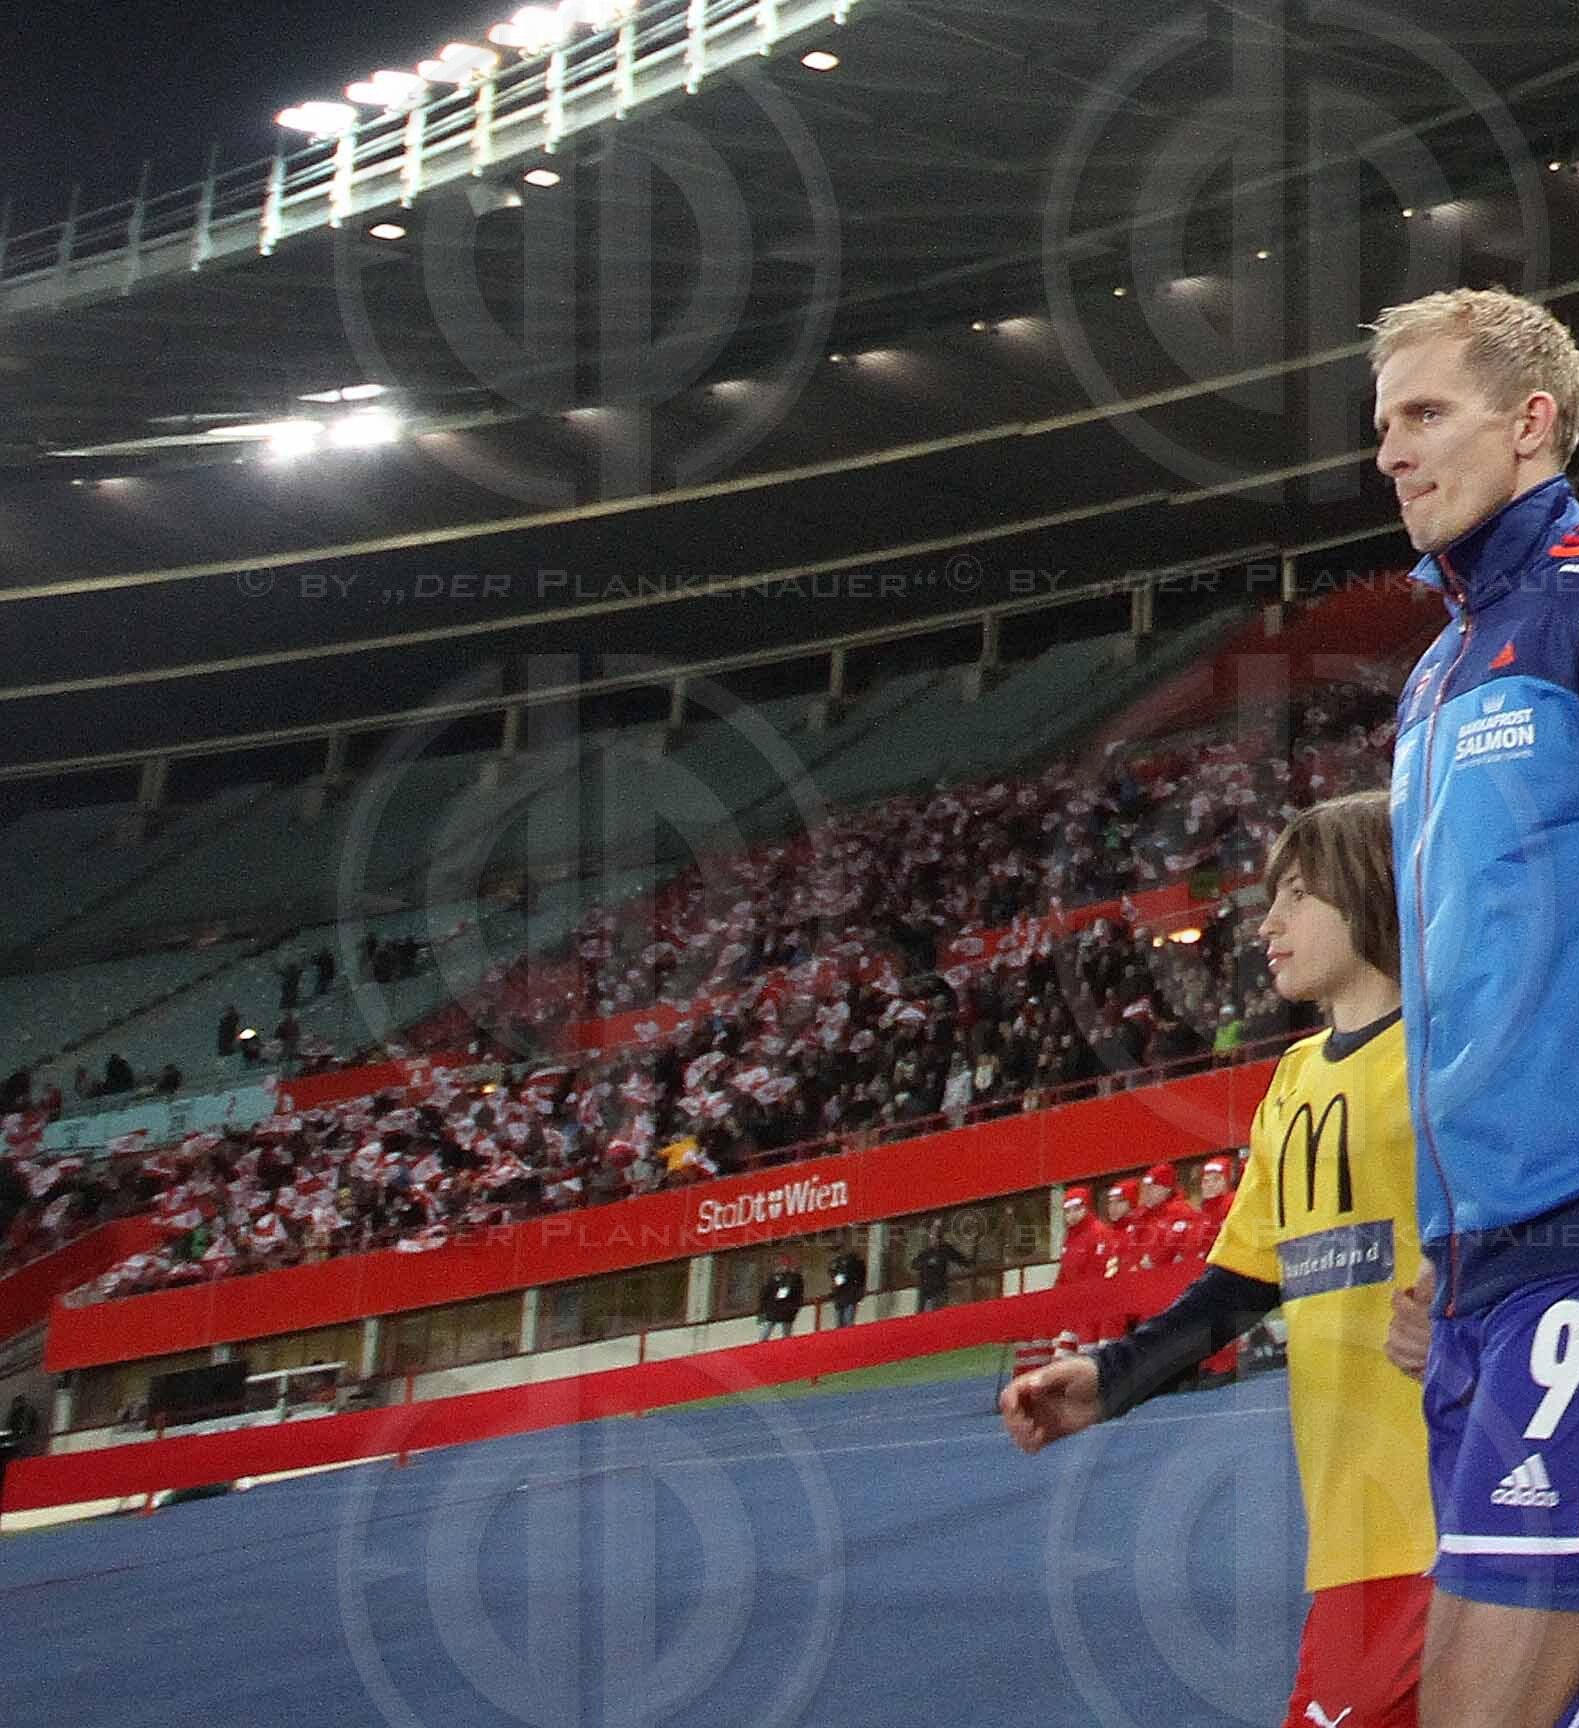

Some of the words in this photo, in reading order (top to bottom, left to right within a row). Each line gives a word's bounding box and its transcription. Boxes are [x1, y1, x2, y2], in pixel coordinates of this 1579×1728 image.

[1455, 724, 1536, 760] SALMON
[784, 1174, 848, 1216] Wien
[1490, 1488, 1559, 1507] adidas
